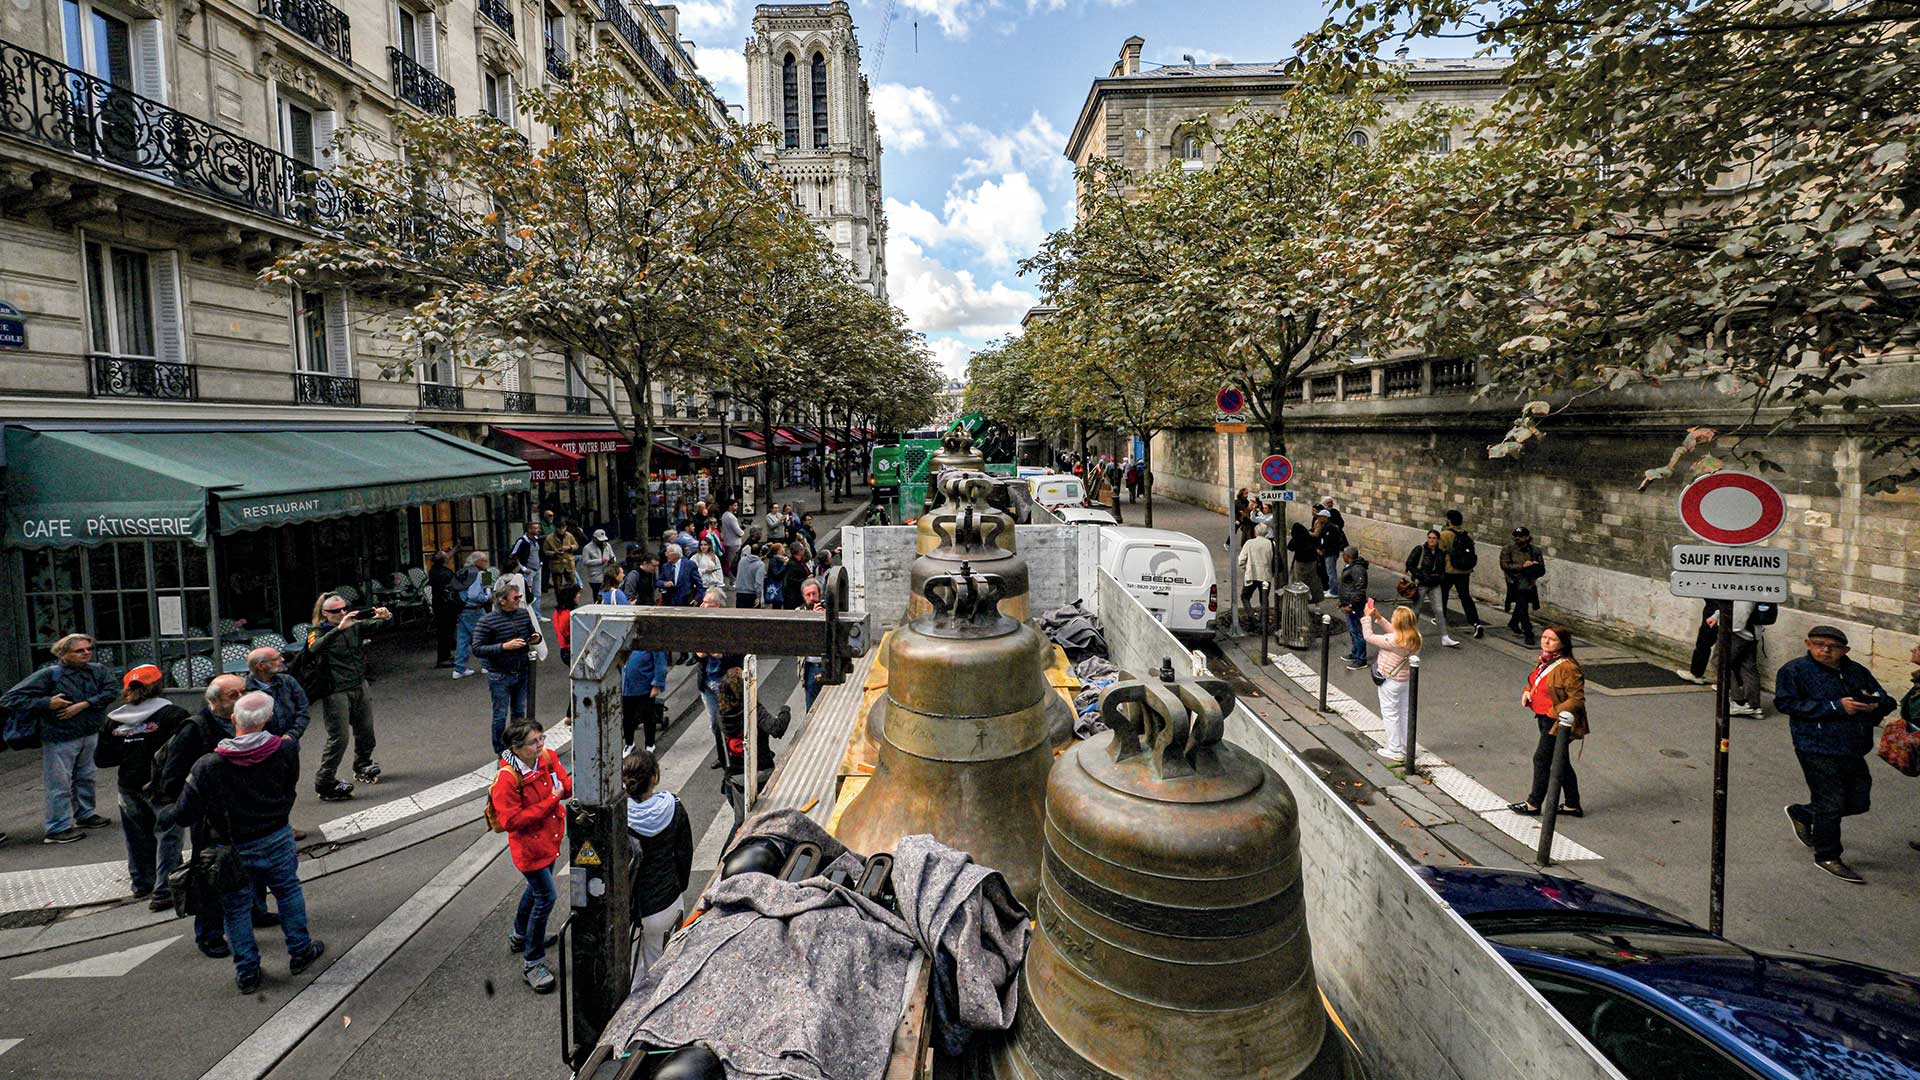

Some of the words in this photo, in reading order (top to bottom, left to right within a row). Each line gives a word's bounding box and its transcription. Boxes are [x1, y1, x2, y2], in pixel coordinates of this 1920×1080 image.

[579, 442, 599, 453] NOTRE
[600, 441, 616, 452] DAME
[548, 470, 570, 479] DAME
[243, 500, 319, 518] RESTAURANT
[23, 519, 72, 538] CAFE
[87, 514, 192, 536] PÂTISSERIE
[1680, 553, 1710, 566] SAUF
[1714, 555, 1780, 568] RIVERAINS
[1141, 575, 1192, 584] BEDEL
[1712, 583, 1780, 593] LIVRAISONS
